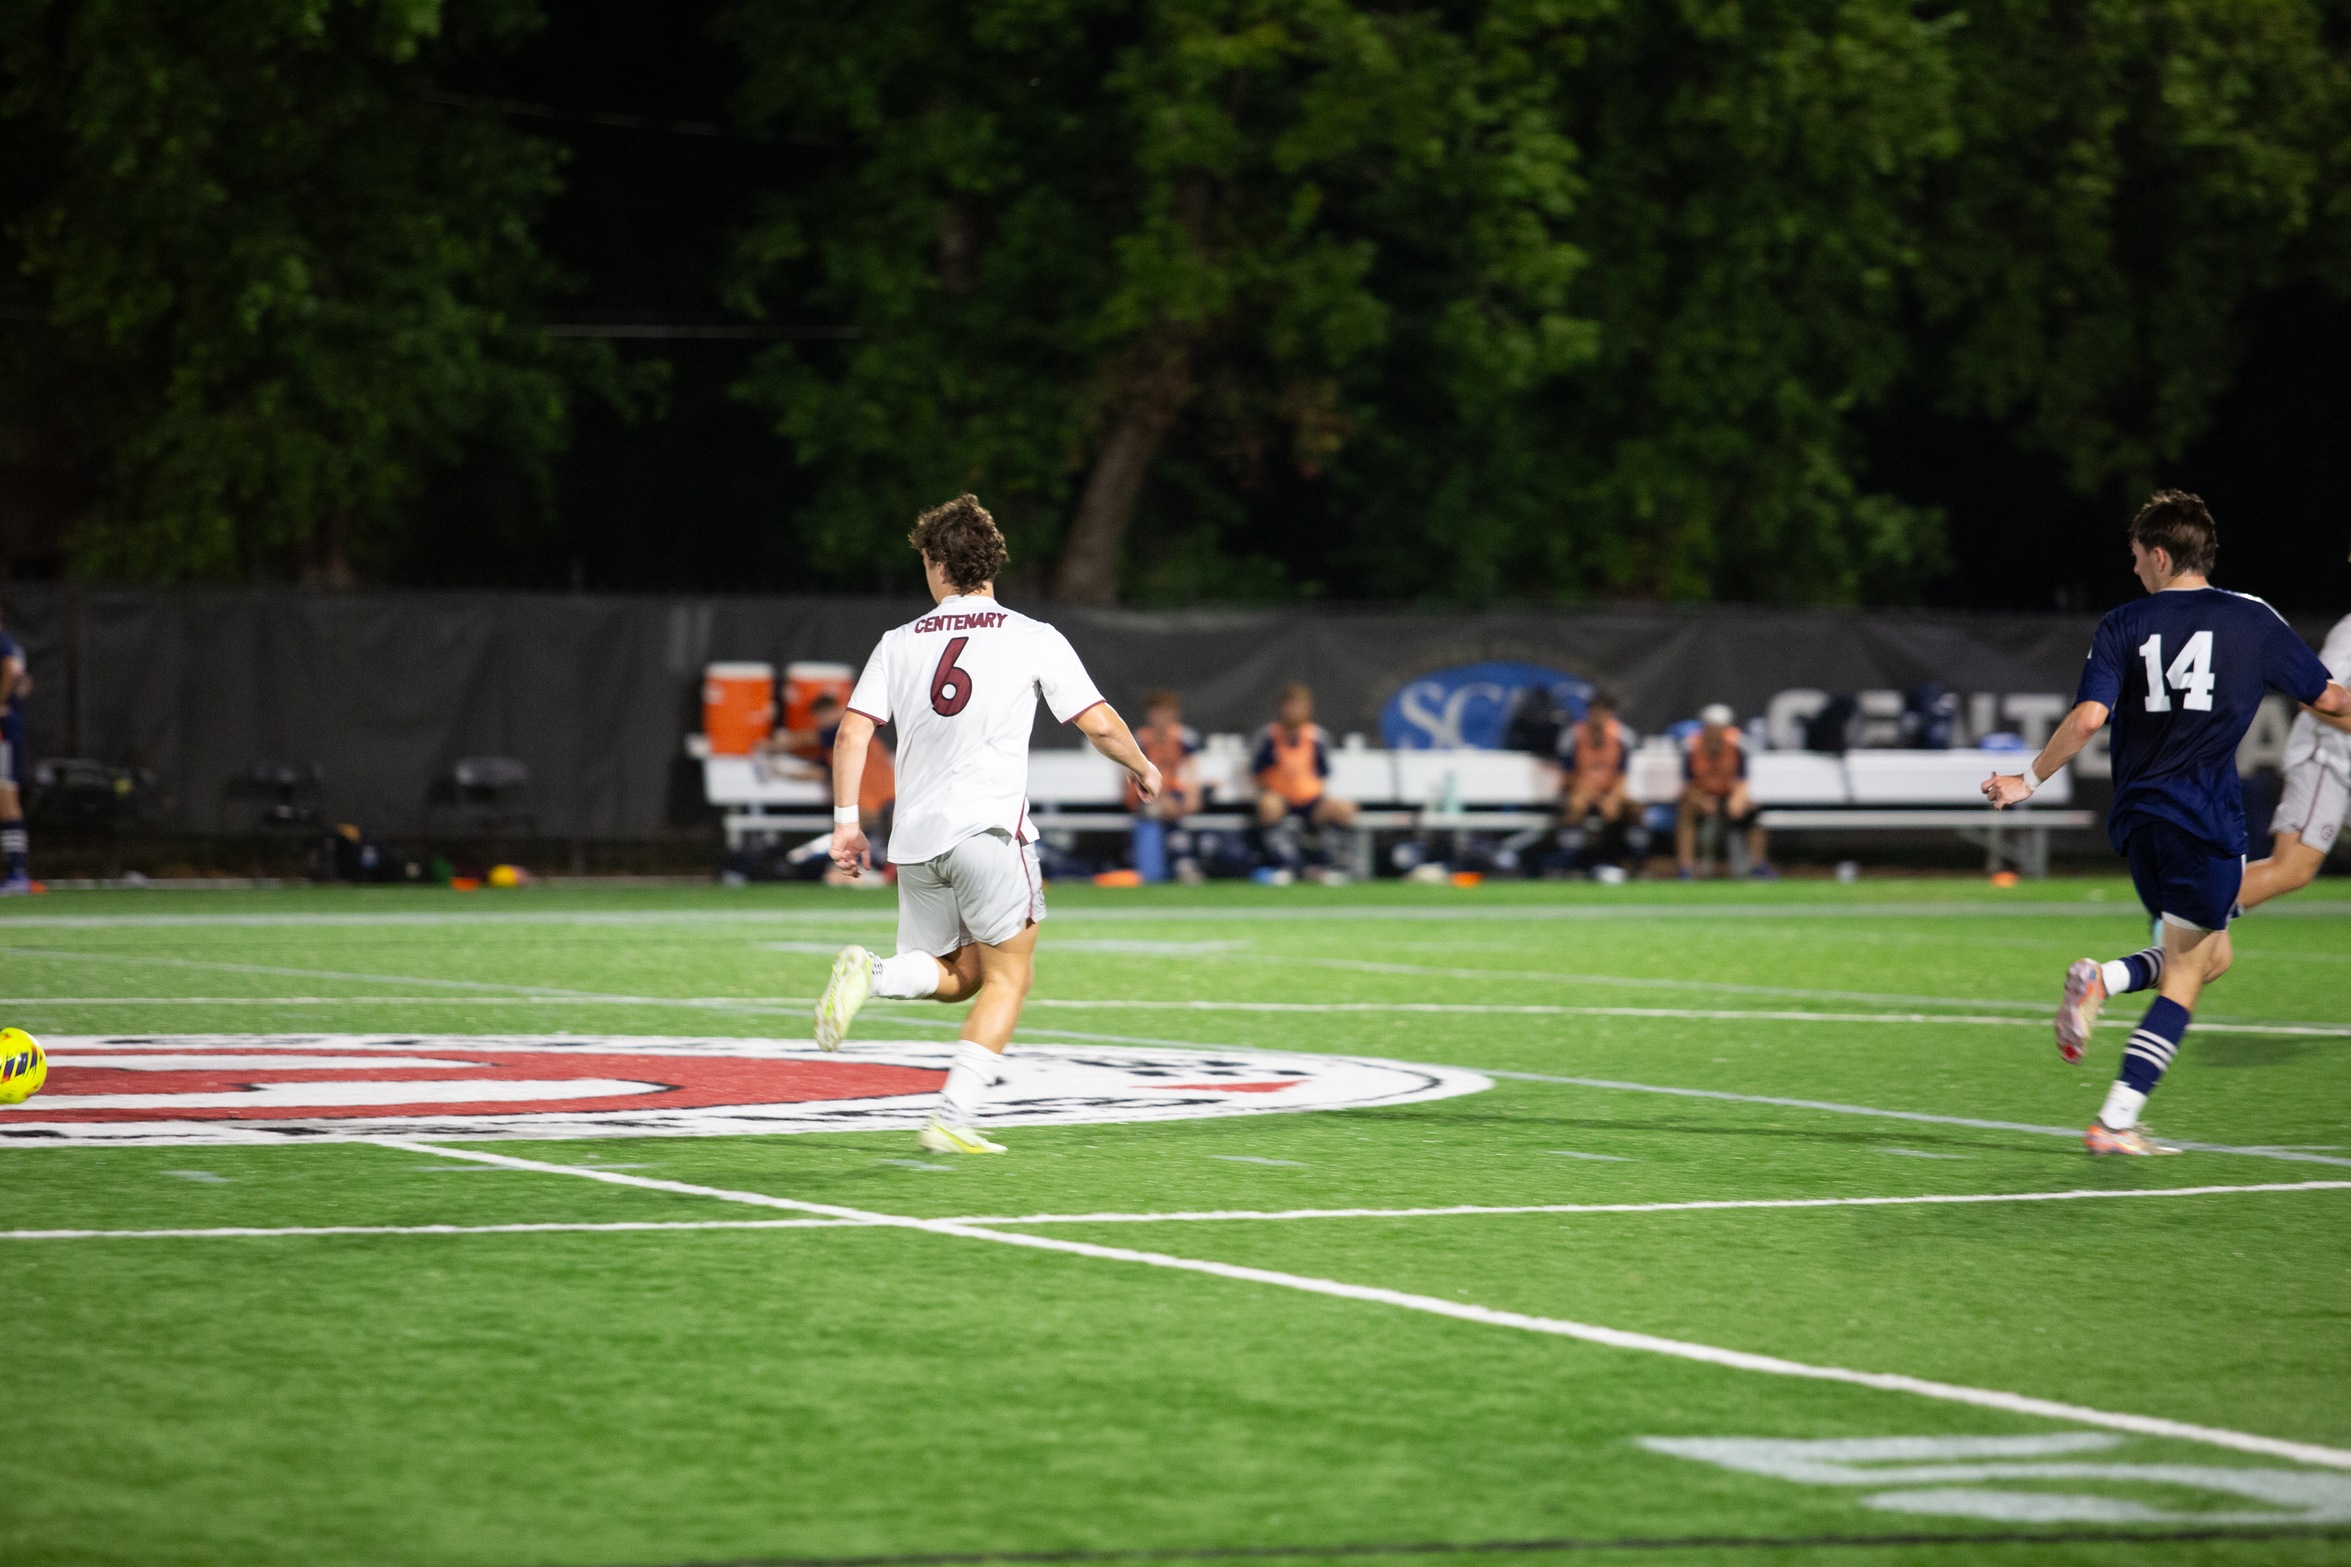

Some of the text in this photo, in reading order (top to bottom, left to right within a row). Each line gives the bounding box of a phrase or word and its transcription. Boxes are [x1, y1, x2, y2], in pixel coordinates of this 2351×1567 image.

[914, 612, 1008, 633] CENTENARY
[930, 636, 972, 717] 6
[2139, 631, 2215, 712] 14
